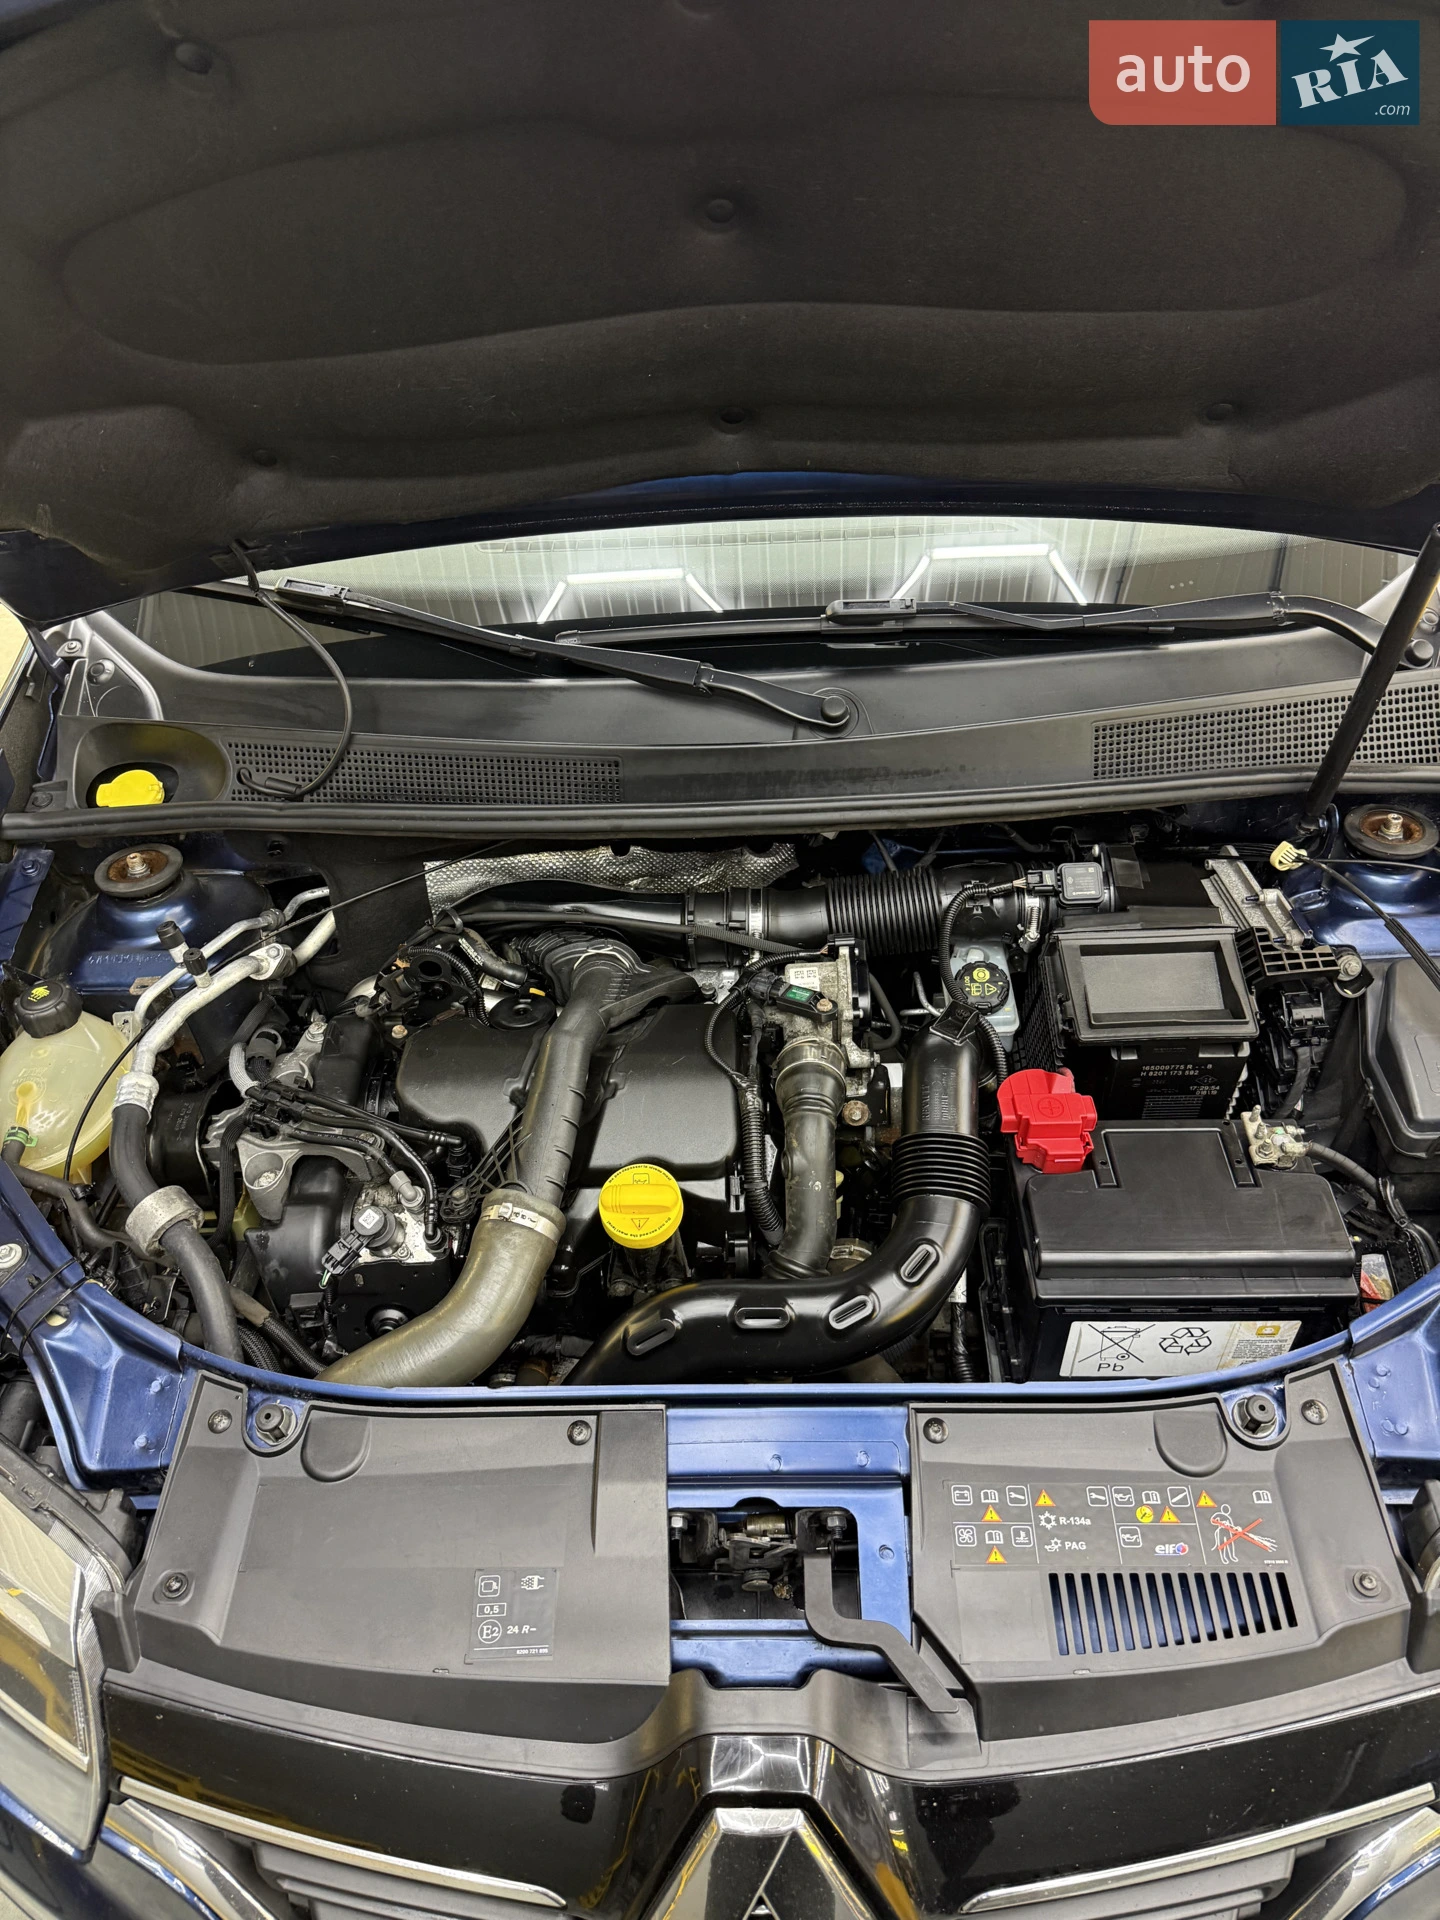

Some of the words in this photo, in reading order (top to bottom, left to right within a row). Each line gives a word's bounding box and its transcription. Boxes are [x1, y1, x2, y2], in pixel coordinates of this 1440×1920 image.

[1097, 1362, 1125, 1372] Pb
[1059, 1516, 1092, 1526] R-134a
[1064, 1541, 1087, 1551] PAG
[1154, 1543, 1176, 1554] elf
[484, 1605, 499, 1615] 0,5
[481, 1625, 499, 1639] E2
[506, 1625, 519, 1634] 24
